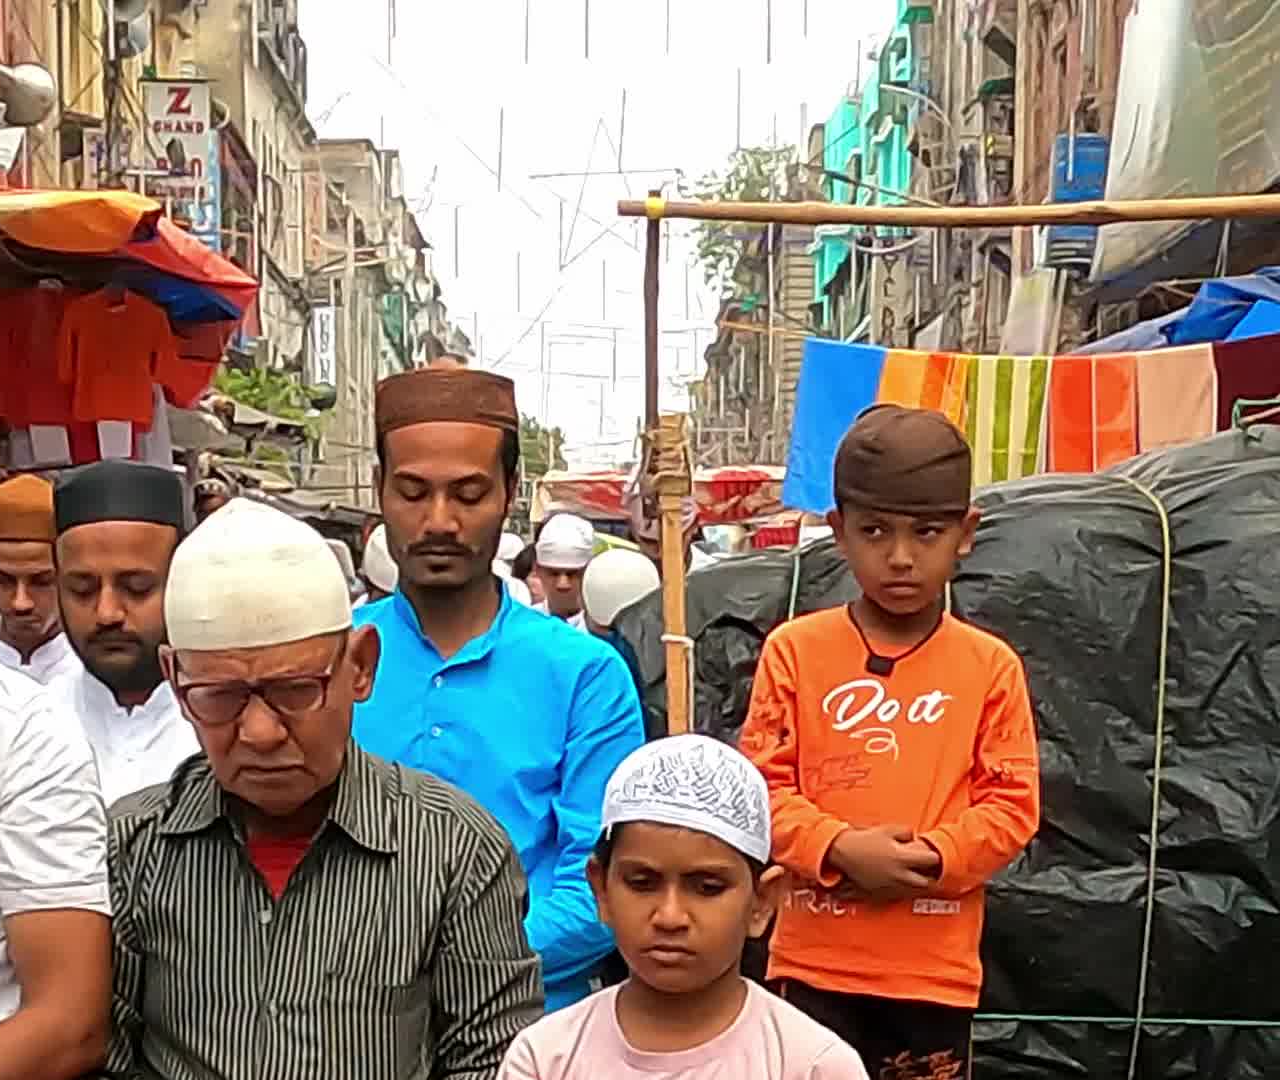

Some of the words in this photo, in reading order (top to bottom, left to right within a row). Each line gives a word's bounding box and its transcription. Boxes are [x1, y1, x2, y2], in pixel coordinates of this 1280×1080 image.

[166, 87, 192, 116] Z
[822, 678, 902, 731] Do
[907, 689, 954, 723] it
